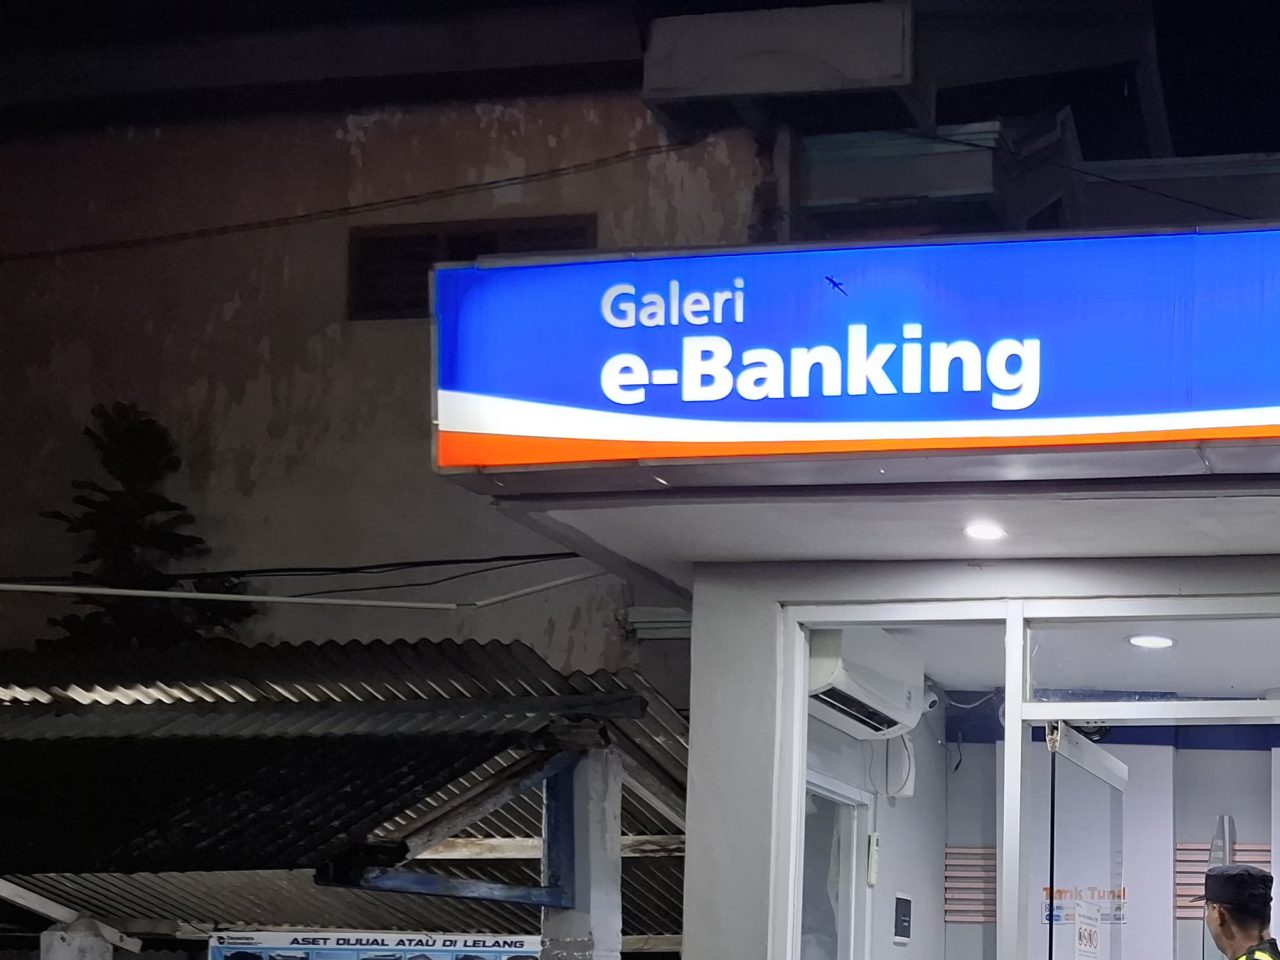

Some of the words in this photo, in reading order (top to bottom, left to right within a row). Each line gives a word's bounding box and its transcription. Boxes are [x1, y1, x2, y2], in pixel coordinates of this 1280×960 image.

[600, 277, 745, 329] Galeri
[600, 324, 1041, 410] e-Banking
[290, 937, 330, 946] ASET
[395, 938, 437, 947] ATAU
[442, 939, 458, 947] DI
[463, 939, 525, 949] LELANG
